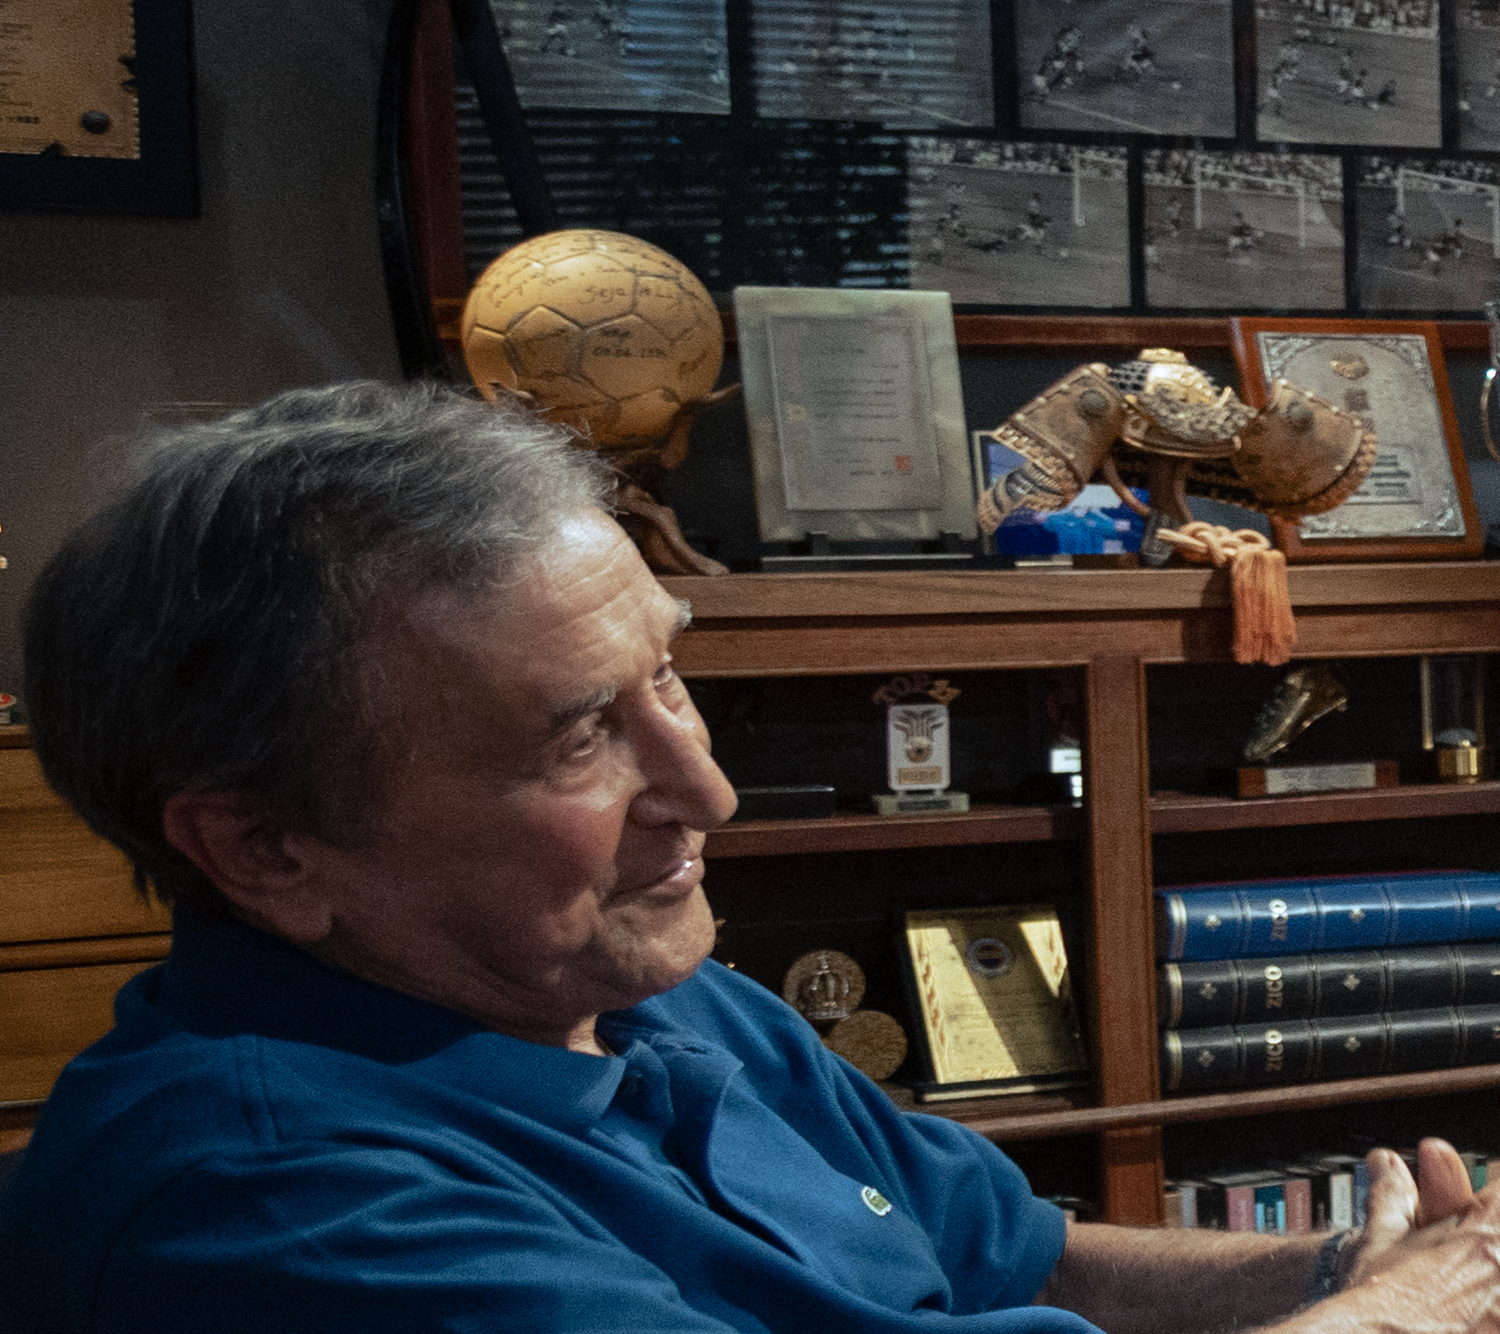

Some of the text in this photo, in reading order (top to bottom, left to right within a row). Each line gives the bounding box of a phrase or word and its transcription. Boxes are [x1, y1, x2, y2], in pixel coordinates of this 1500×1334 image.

[1268, 898, 1289, 942] ZICO
[1263, 965, 1284, 1009] ZICO
[1264, 1029, 1284, 1072] ZICO
